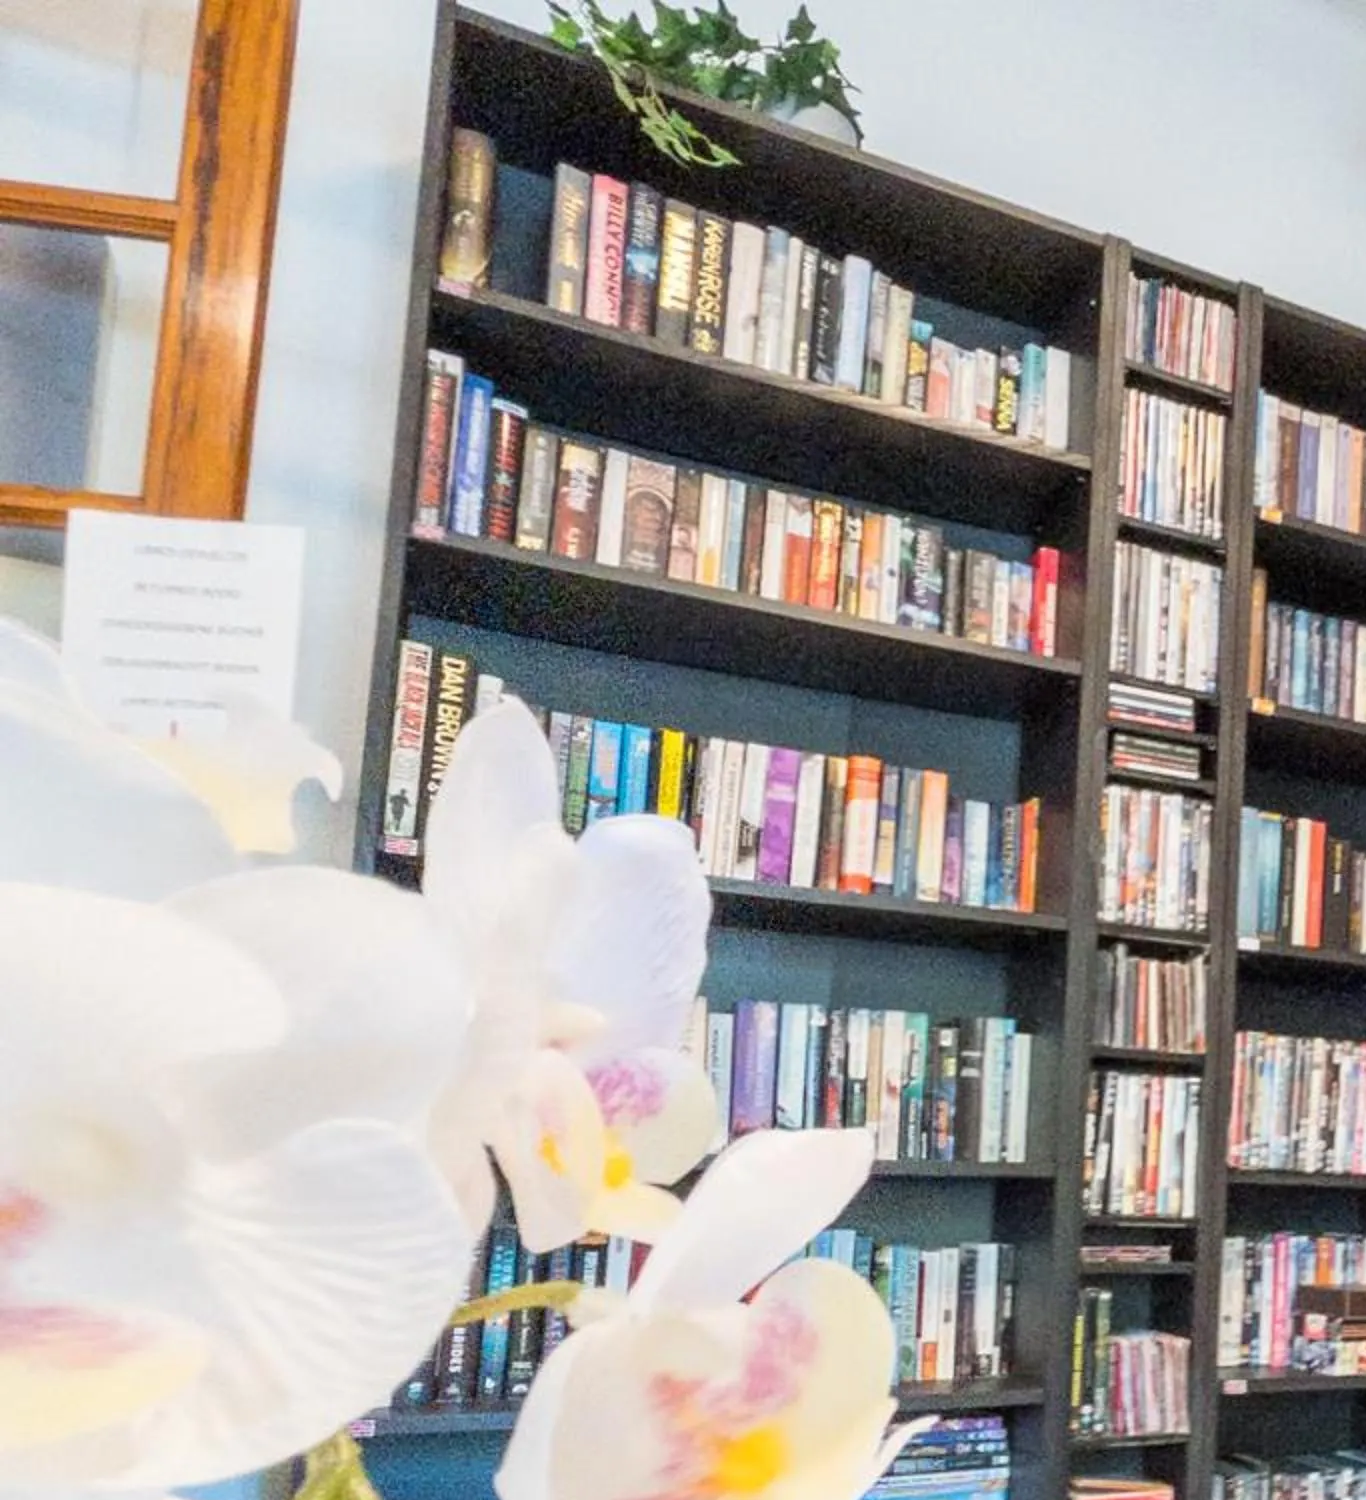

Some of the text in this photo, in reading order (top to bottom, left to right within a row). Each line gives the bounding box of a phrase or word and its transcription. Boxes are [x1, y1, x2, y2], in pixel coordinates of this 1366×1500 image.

[605, 192, 624, 242] BILLY
[696, 218, 727, 329] KAREN ROSE
[440, 655, 467, 703] DAN
